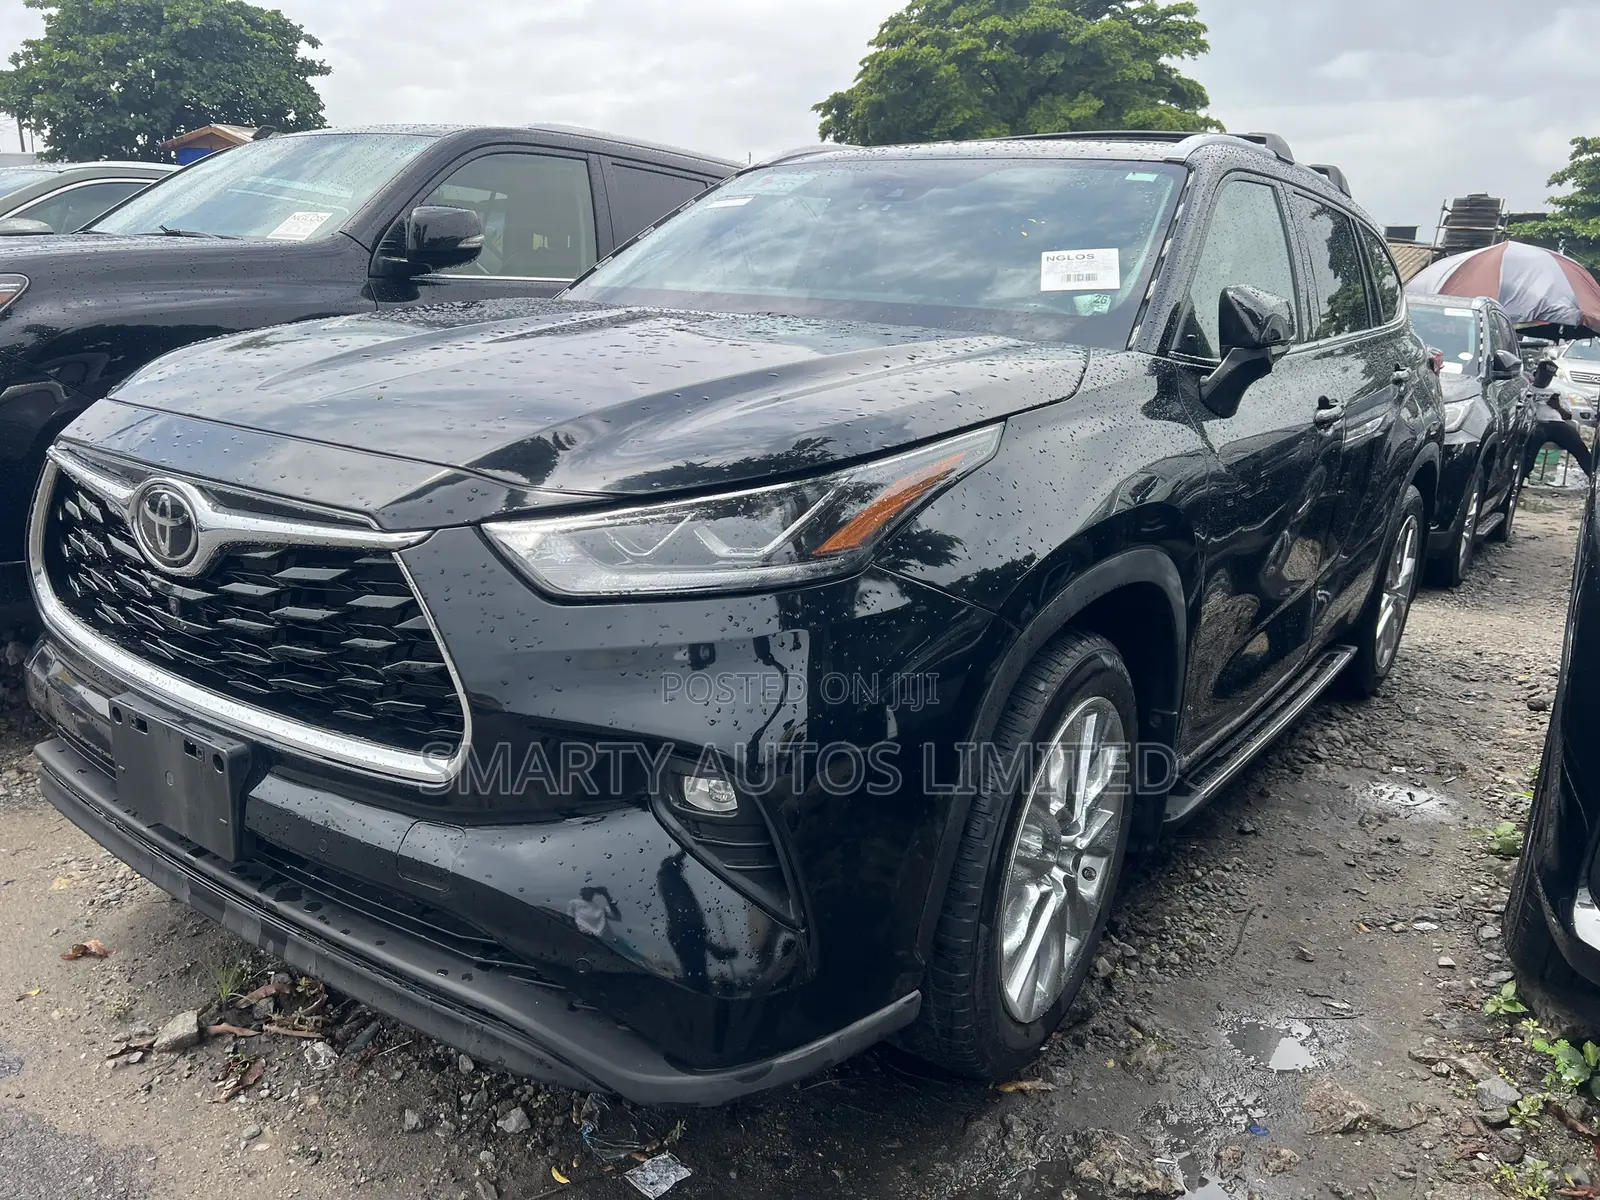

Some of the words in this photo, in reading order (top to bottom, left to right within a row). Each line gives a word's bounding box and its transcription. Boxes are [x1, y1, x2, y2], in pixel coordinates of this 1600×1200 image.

[290, 214, 326, 222] NGLOS
[1046, 253, 1095, 262] NGLOS
[1093, 294, 1108, 305] 26
